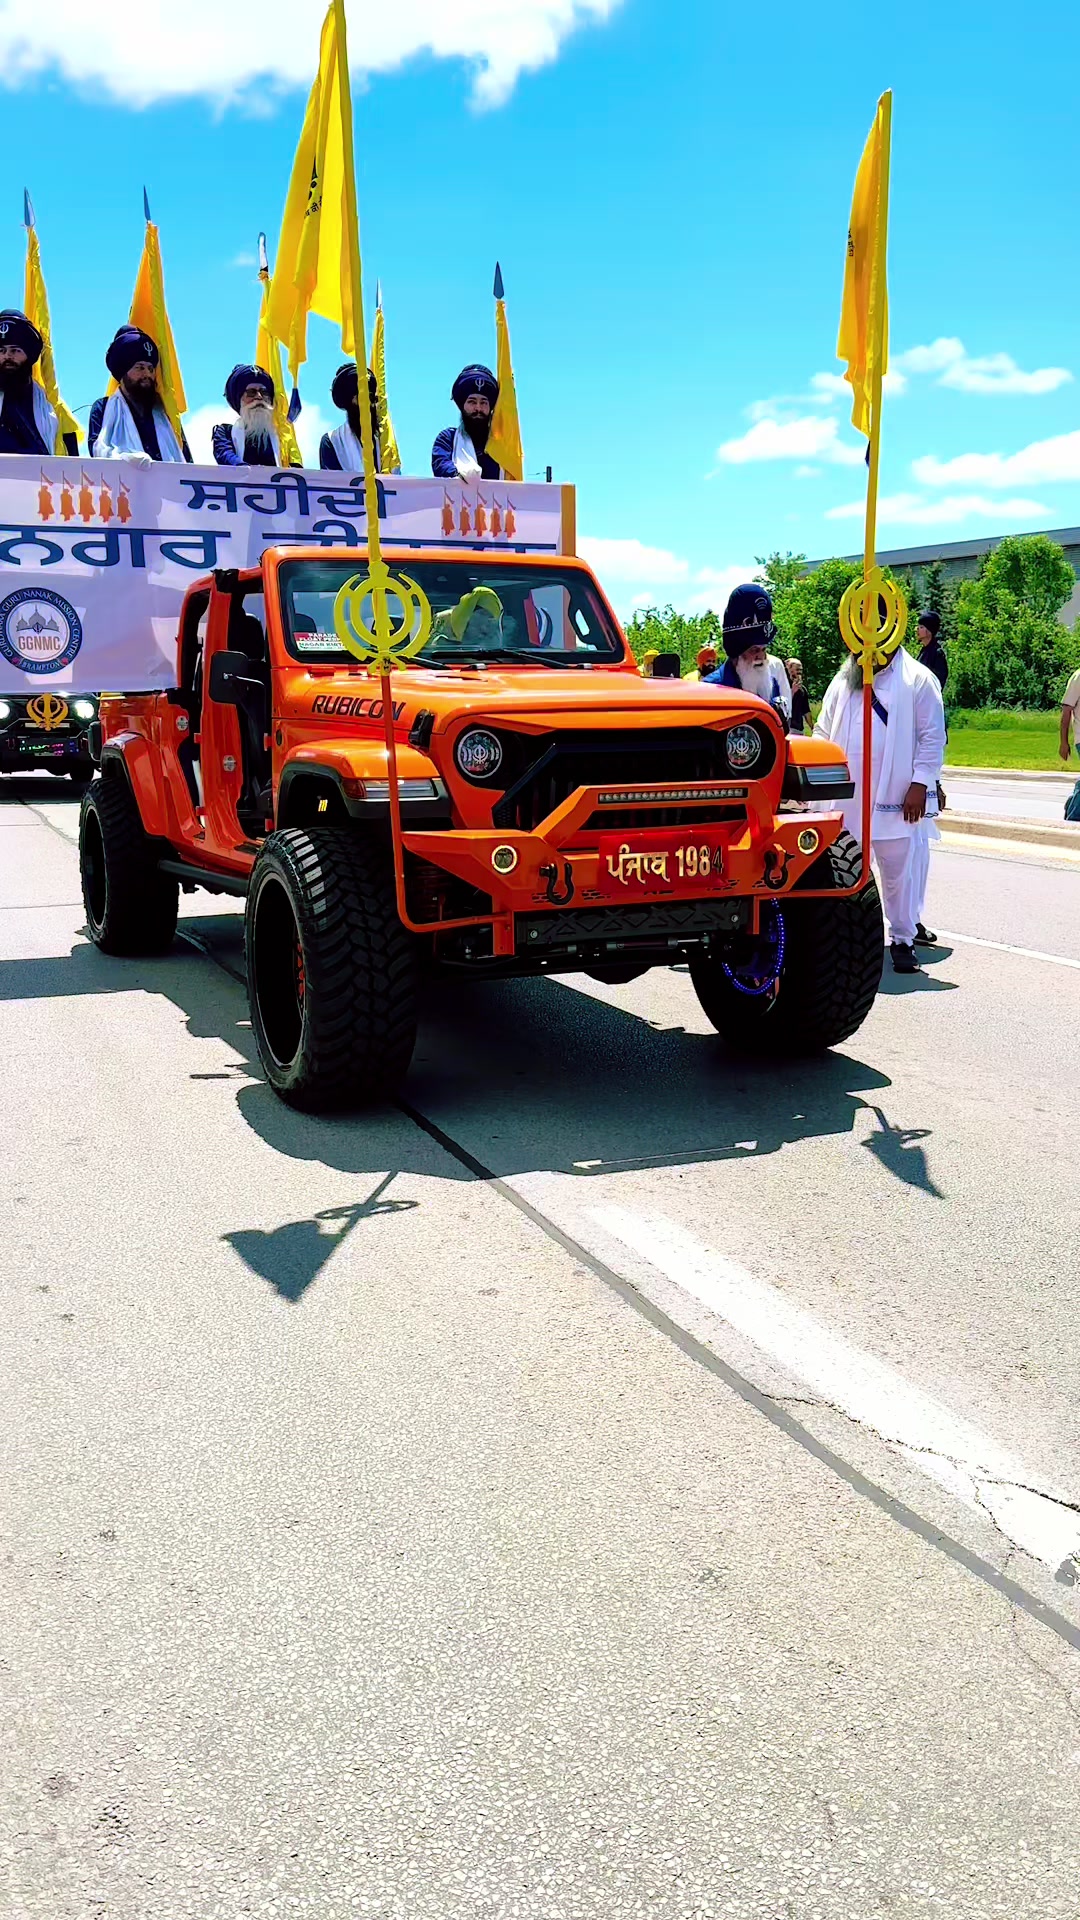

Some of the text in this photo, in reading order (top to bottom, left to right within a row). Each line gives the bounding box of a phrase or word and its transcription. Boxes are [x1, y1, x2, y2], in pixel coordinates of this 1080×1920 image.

[180, 472, 397, 519] ਸ਼ਹੀਦੀ
[0, 524, 231, 569] ਨਗਰ
[1, 593, 22, 612] GURU
[23, 590, 53, 600] NANAK
[53, 597, 78, 626] MISSION
[66, 628, 79, 658] CENTRE
[18, 636, 60, 651] GGNMC
[21, 661, 60, 671] BRAMPTON
[311, 695, 406, 721] RUBICON
[606, 844, 724, 885] ਪੰਜਾਬ 1984
